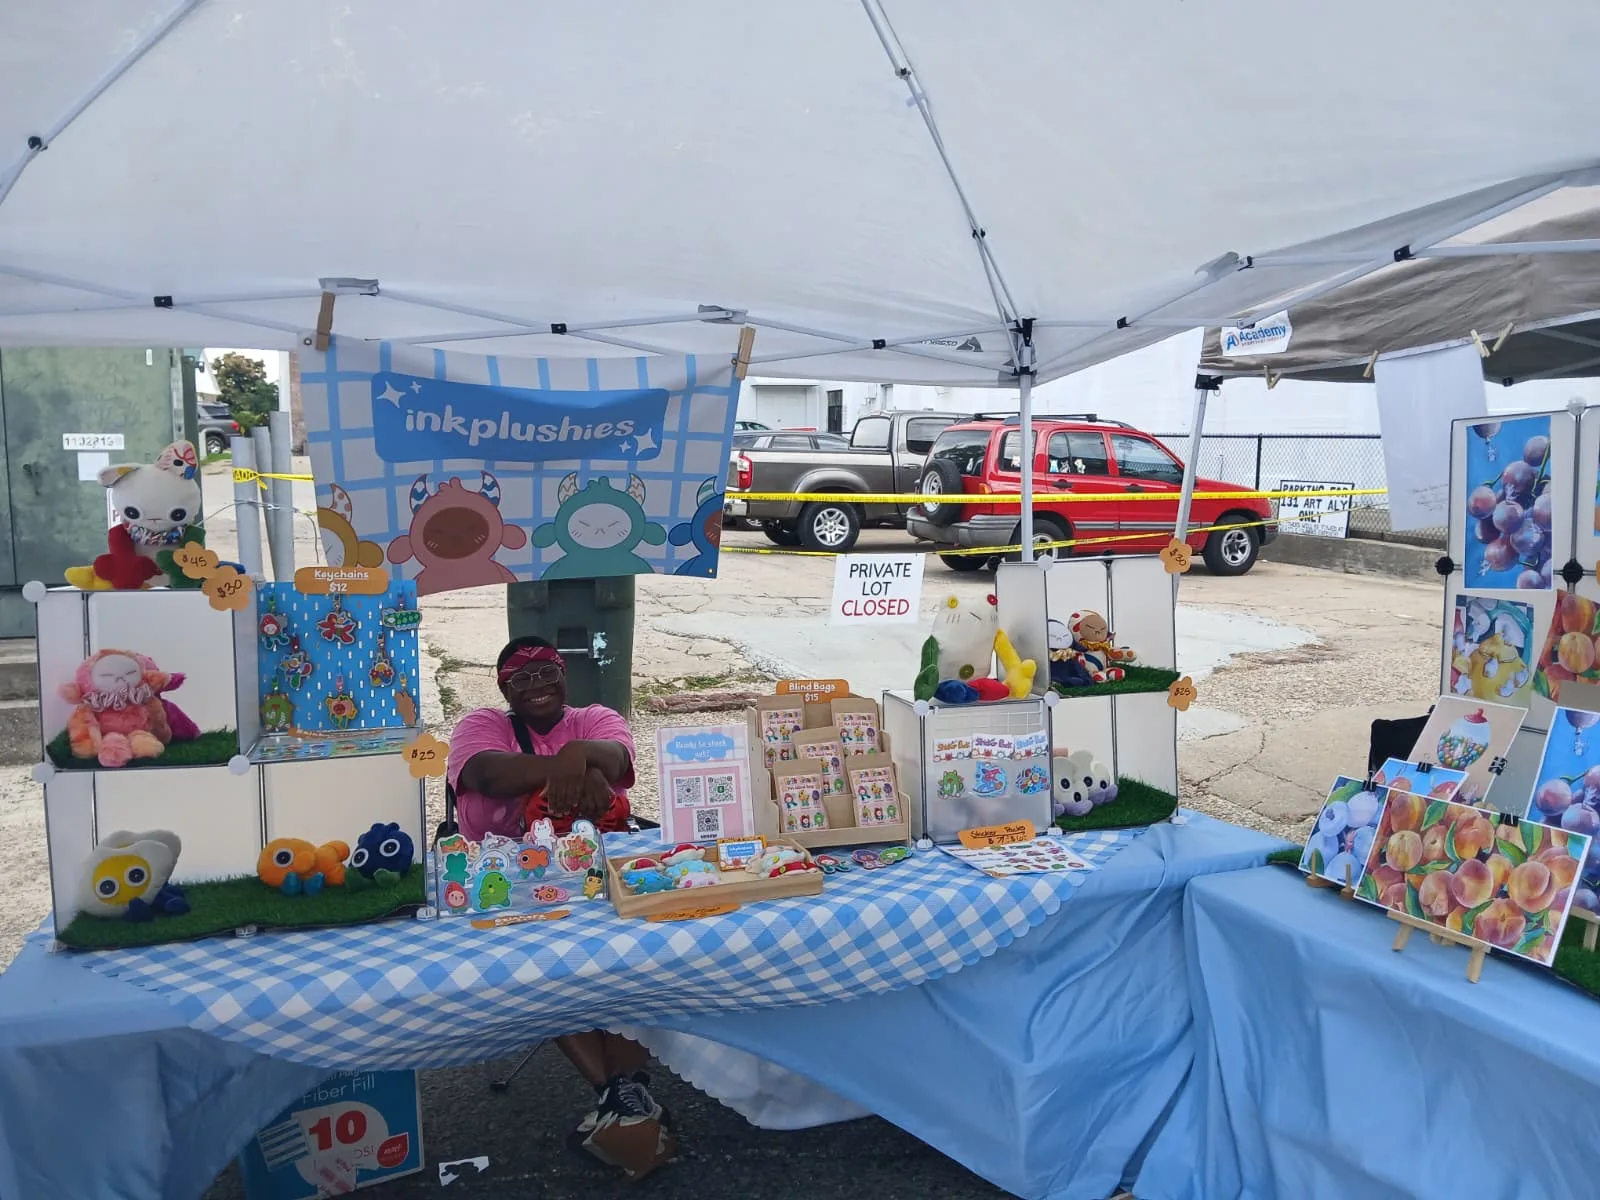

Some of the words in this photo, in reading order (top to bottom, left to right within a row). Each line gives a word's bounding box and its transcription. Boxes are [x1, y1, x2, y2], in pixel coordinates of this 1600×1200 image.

[1239, 324, 1287, 341] Academy
[405, 405, 635, 446] inkplushies
[1281, 496, 1299, 508] 131
[1303, 498, 1322, 509] ART
[1327, 500, 1348, 511] ALY
[1299, 510, 1323, 523] ONLY
[182, 554, 208, 568] $45
[314, 568, 369, 582] Keychains
[849, 562, 912, 579] PRIVATE
[216, 579, 242, 598] $30
[329, 582, 348, 592] $12
[861, 581, 892, 596] LOT
[841, 598, 910, 617] CLOSED
[788, 681, 812, 691] Blind
[813, 682, 836, 693] Bags
[1174, 687, 1191, 697] $25
[805, 692, 819, 702] $15
[411, 748, 436, 761] $25
[303, 1084, 348, 1105] Fiber
[352, 1073, 375, 1094] Fill
[309, 1110, 367, 1151] 10
